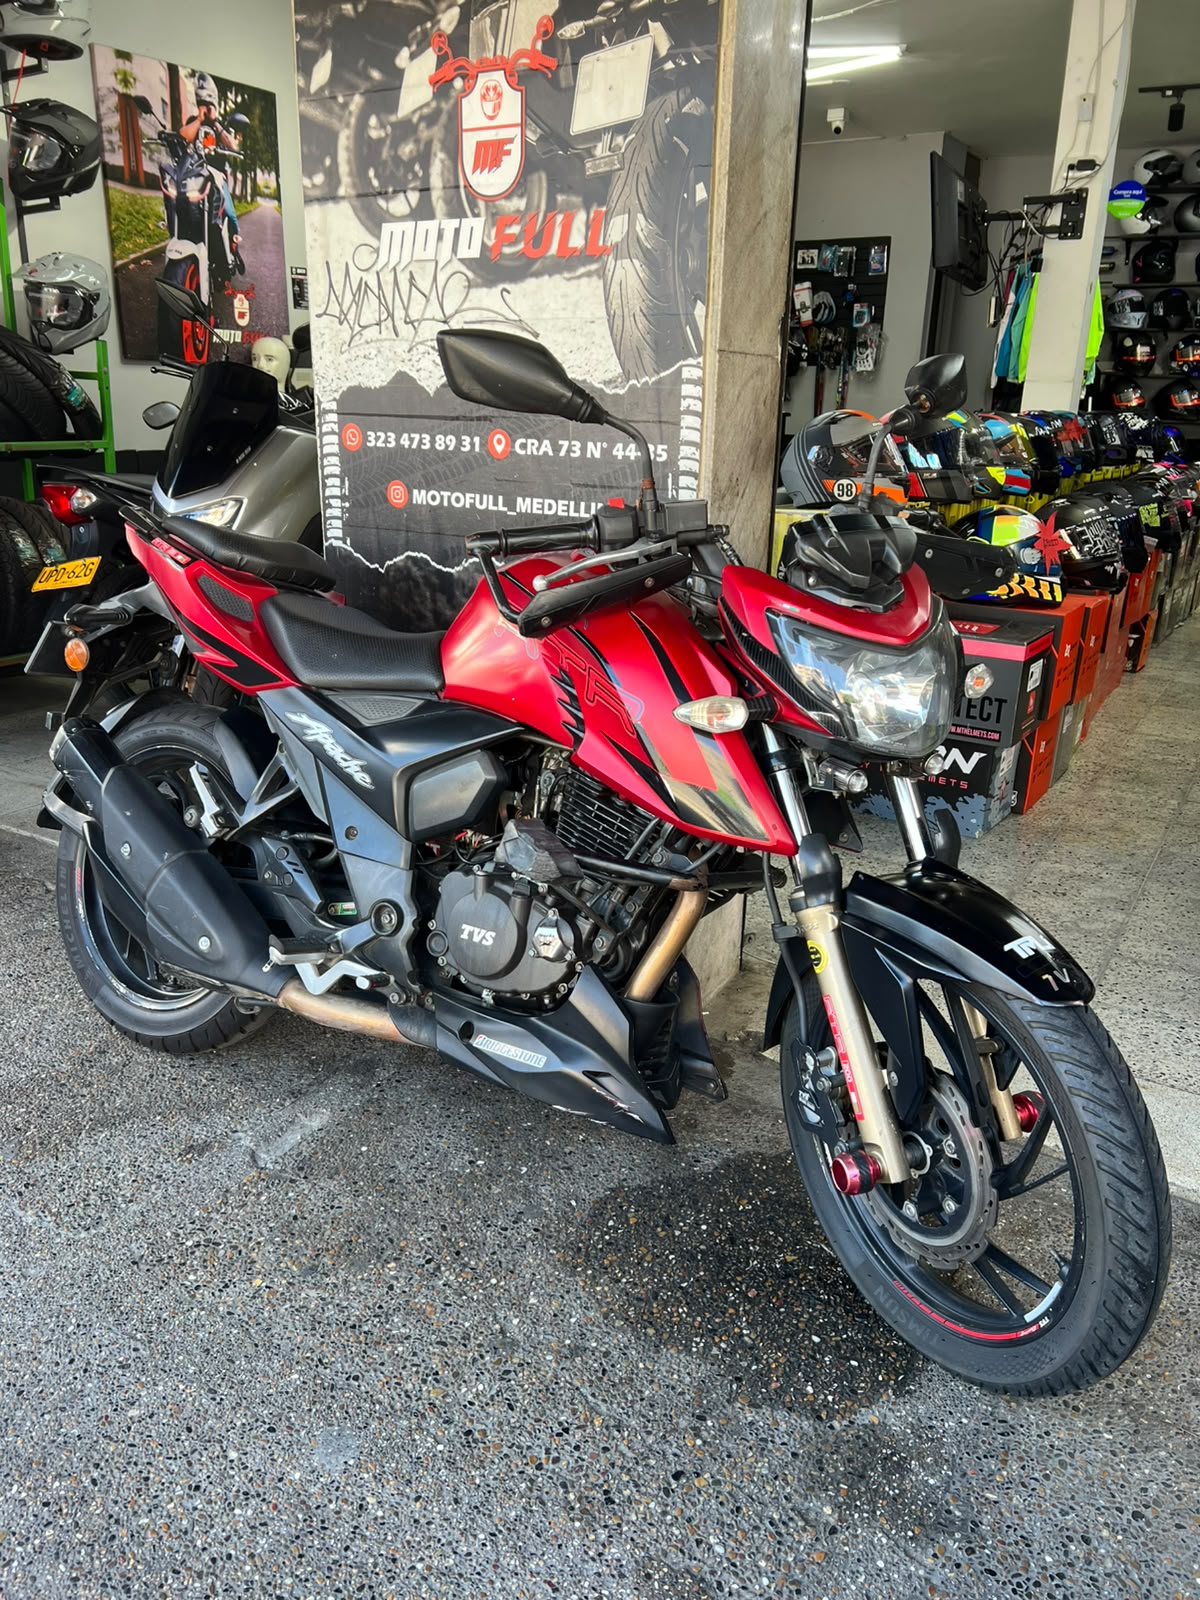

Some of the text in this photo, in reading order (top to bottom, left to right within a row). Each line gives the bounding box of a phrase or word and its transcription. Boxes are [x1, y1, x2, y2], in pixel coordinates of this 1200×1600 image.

[472, 134, 518, 175] MF
[377, 208, 615, 272] MOTO FULL
[366, 431, 397, 448] 323
[400, 433, 431, 450] 473
[435, 434, 457, 451] 89
[460, 435, 481, 452] 31
[514, 438, 554, 457] CRA
[558, 440, 581, 458] 73
[837, 482, 853, 498] 98
[284, 711, 376, 790] Apache
[460, 923, 497, 946] TVS
[474, 1034, 547, 1068] BRIDGESTONE
